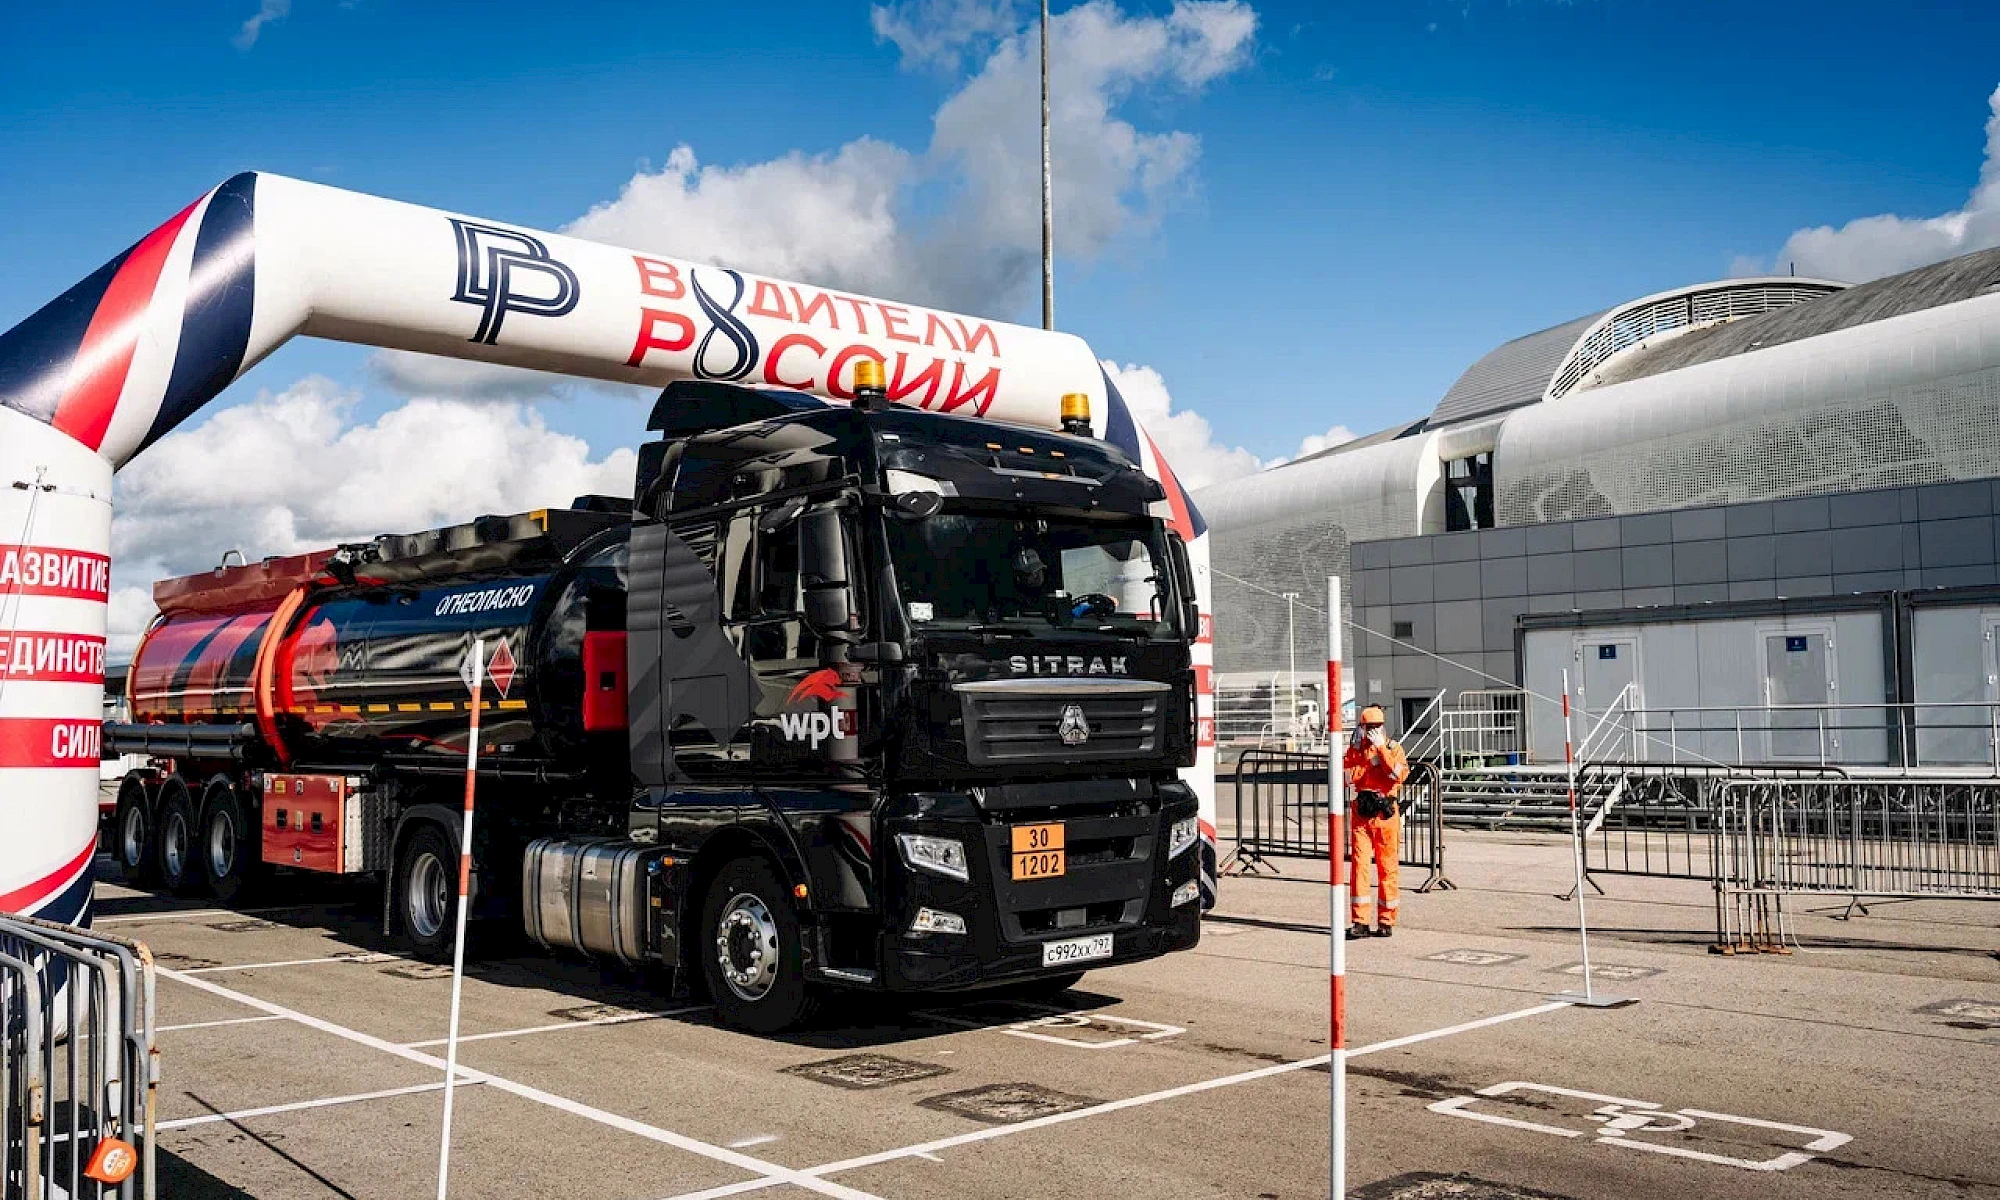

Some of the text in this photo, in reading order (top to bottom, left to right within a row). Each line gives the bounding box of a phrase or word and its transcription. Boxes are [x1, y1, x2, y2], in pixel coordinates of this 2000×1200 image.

[435, 584, 534, 616] ОГНЕОПАСНО
[0, 636, 105, 676] ЕДИНСТВ
[1010, 655, 1127, 674] SITRAK
[52, 723, 100, 759] СИЛА
[780, 706, 844, 750] wpt
[1029, 827, 1049, 848] 30
[1020, 853, 1059, 876] 1202
